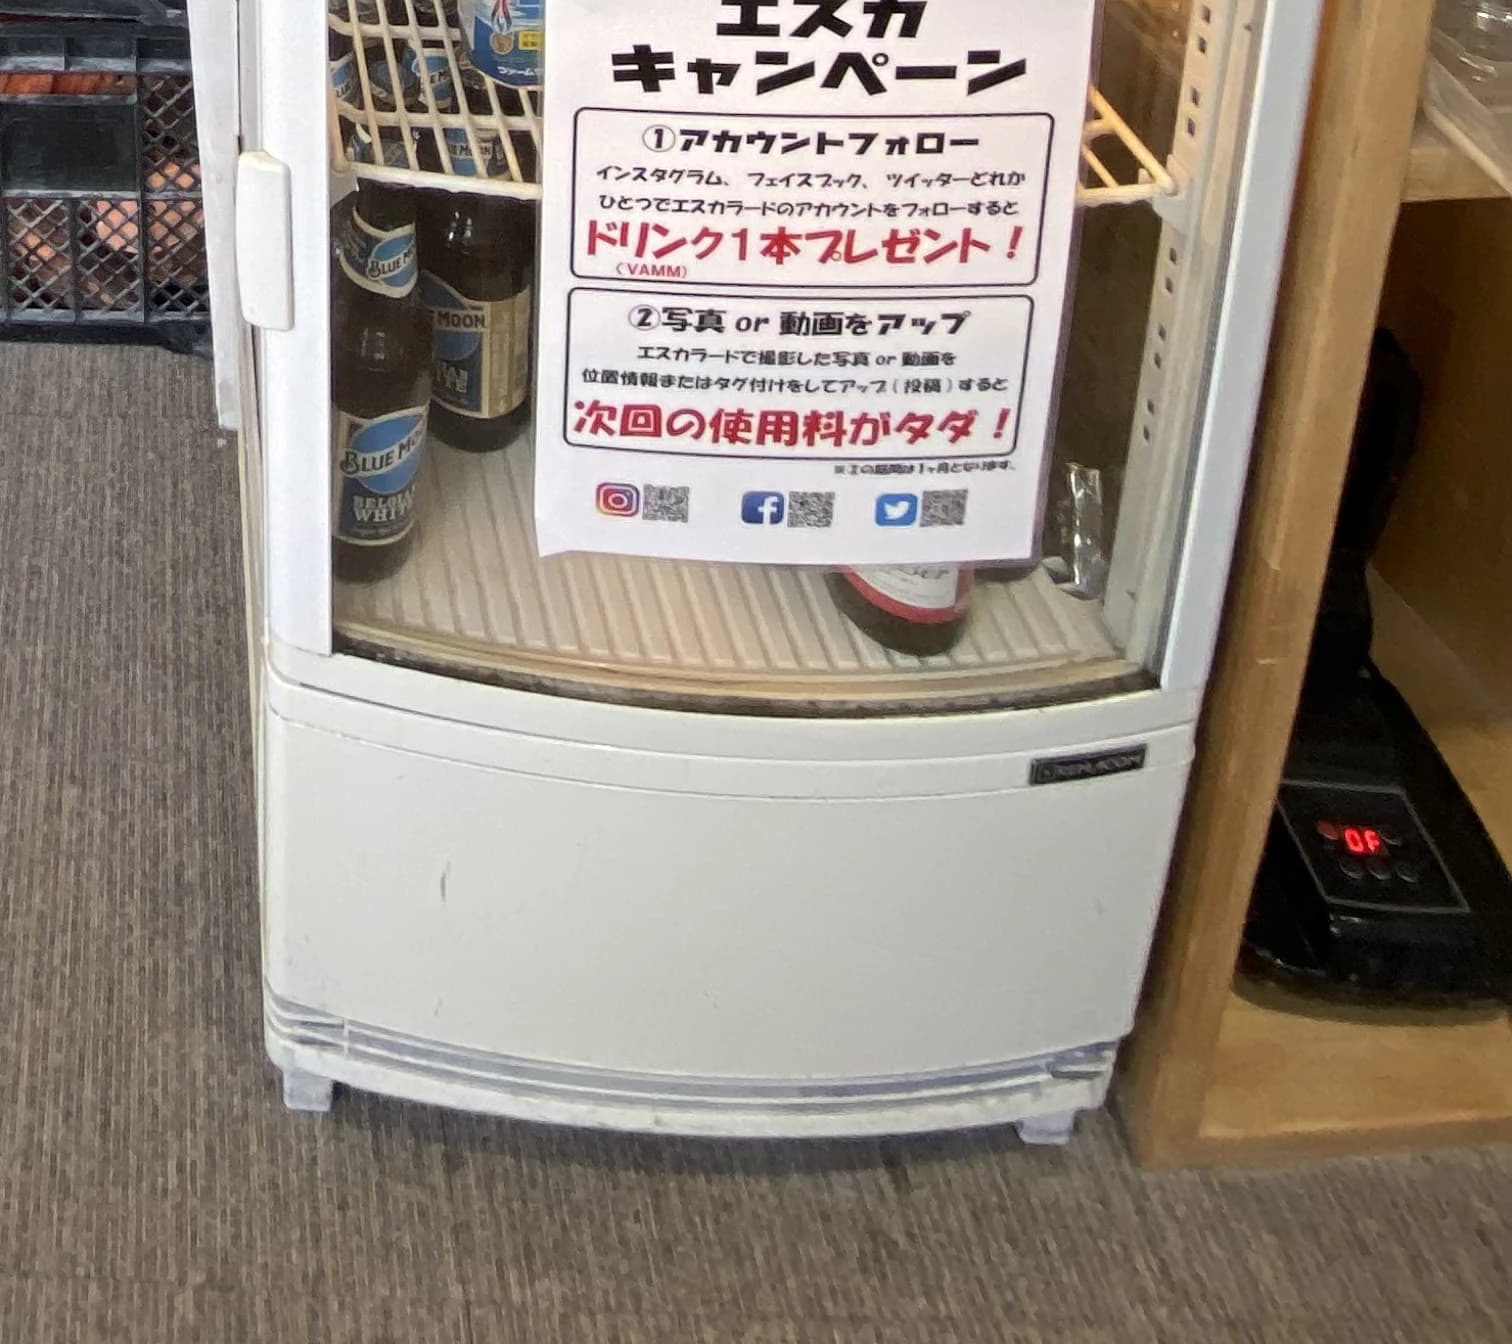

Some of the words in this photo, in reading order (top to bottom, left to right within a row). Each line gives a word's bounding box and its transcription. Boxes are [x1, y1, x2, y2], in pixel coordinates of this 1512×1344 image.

[611, 43, 1027, 97] キャンペーン
[642, 124, 980, 156] ①アカウントフォロー
[367, 256, 400, 279] BLUE
[437, 311, 486, 329] MOON
[734, 314, 771, 333] or
[779, 309, 972, 337] 動画をアップ
[875, 353, 898, 367] or
[340, 448, 395, 477] BLUE
